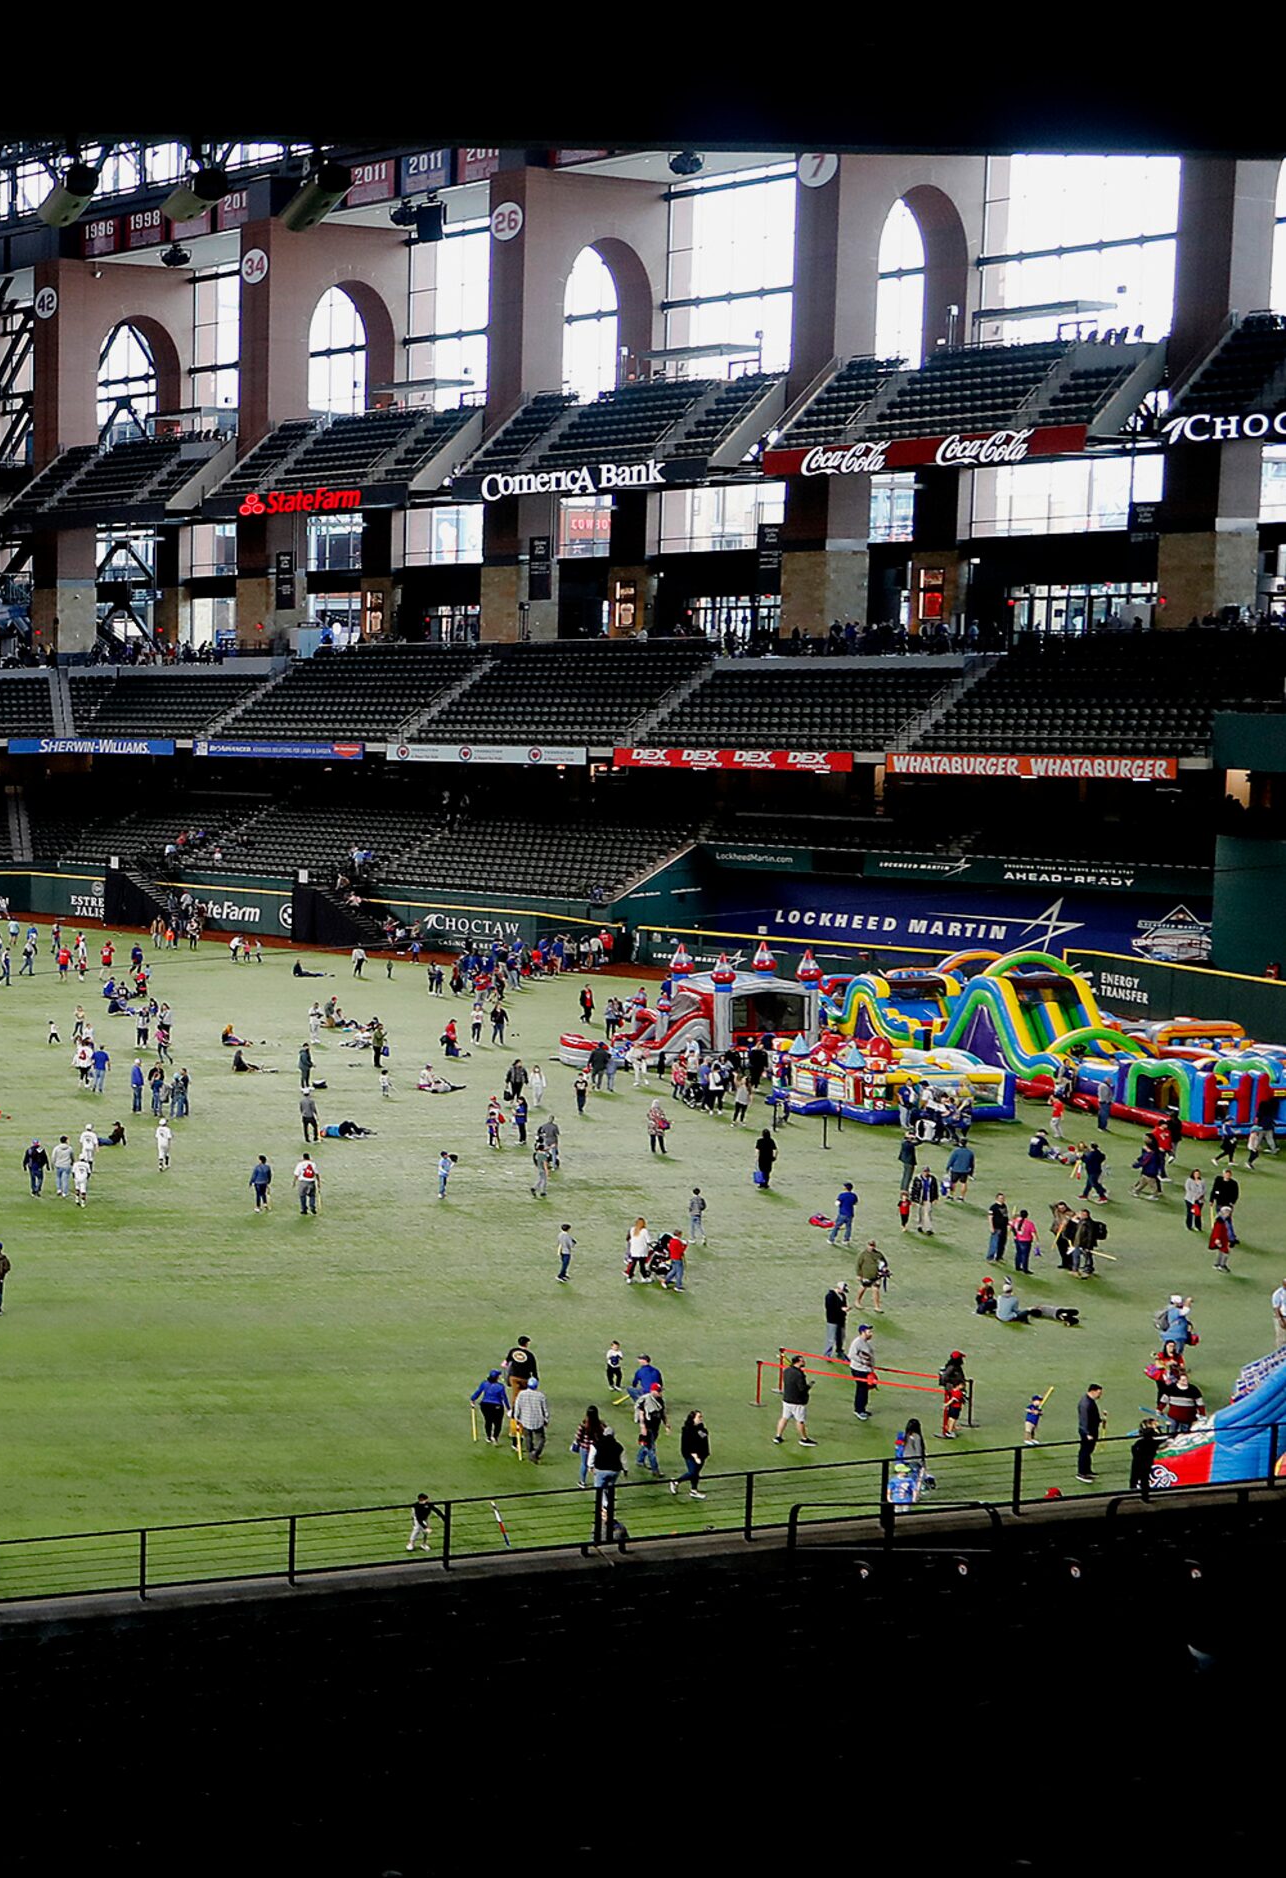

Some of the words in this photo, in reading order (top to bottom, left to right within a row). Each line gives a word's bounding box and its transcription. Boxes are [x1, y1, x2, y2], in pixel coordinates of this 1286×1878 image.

[408, 151, 442, 174] 2011
[810, 153, 825, 179] 7
[354, 163, 387, 185] 2011
[85, 220, 114, 240] 1996
[130, 210, 161, 230] 1998
[494, 210, 520, 232] 26
[245, 257, 265, 277] 34
[37, 293, 54, 312] 42
[935, 428, 1035, 466] Coca-Cola
[801, 440, 892, 477] Coca-Cola
[598, 459, 666, 488] Bank
[631, 749, 669, 760] DEX
[682, 750, 720, 761] DEX
[733, 751, 772, 762] DEX
[787, 752, 828, 764] DEX
[716, 852, 793, 863] LockheedMartin.com
[1003, 871, 1134, 887] AHEAD-READY
[775, 909, 898, 932] LOCKHEED
[908, 918, 1007, 940] MARTIN
[1101, 971, 1139, 989] ENERGY
[1101, 985, 1149, 1004] TRANSFER
